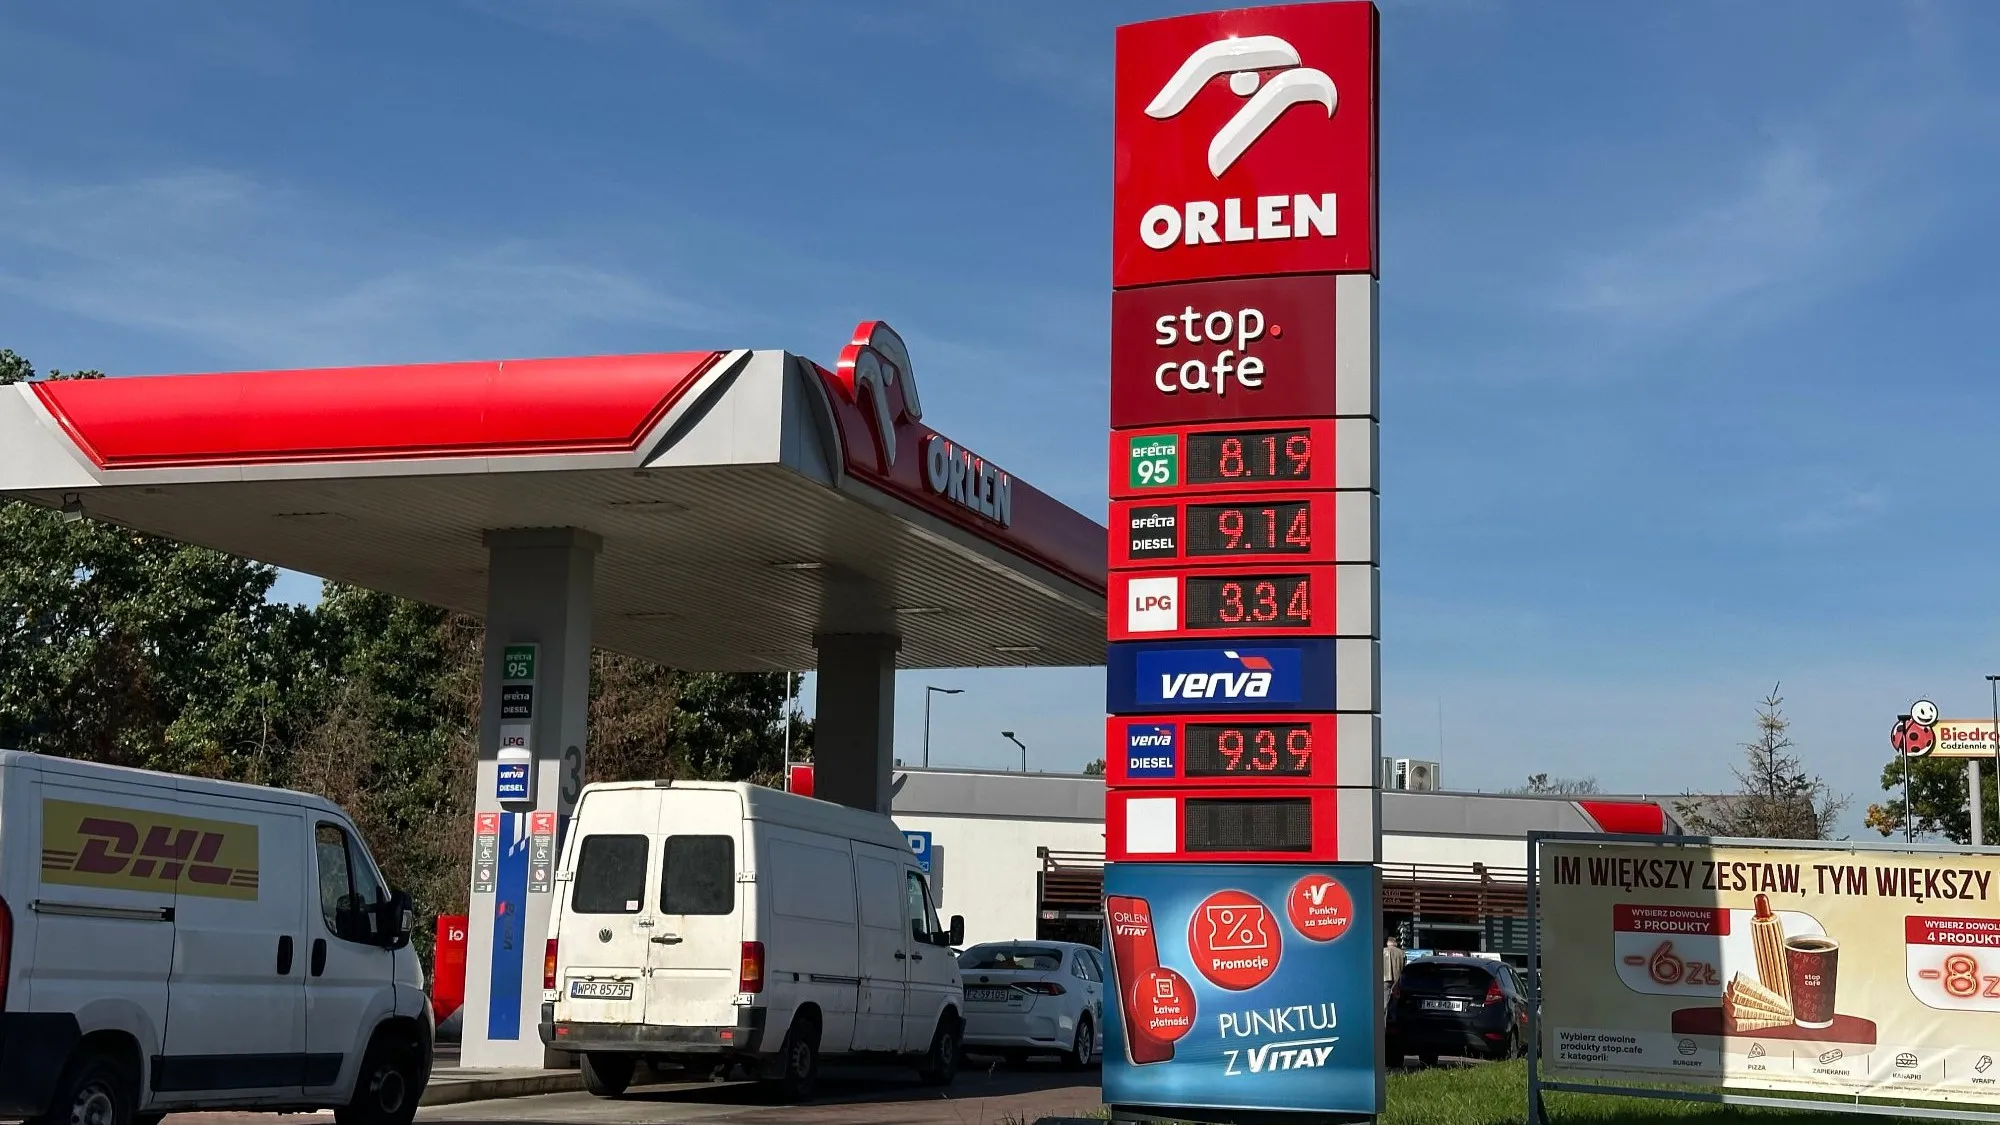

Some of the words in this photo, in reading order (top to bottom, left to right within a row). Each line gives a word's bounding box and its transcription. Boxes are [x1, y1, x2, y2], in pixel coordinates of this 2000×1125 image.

[1140, 193, 1337, 250] ORLEN
[1155, 350, 1264, 394] cafe
[1219, 435, 1311, 477] 8.19
[1137, 459, 1170, 484] 95
[926, 435, 1012, 529] ORLEN
[1218, 508, 1311, 549] 9.14
[1132, 537, 1175, 551] DIESEL
[1135, 595, 1171, 612] LPG
[1219, 580, 1311, 622] 3.34
[508, 662, 527, 677] 95
[1161, 672, 1273, 699] verva
[503, 705, 529, 714] DIESEL
[503, 737, 525, 746] LPG
[1131, 735, 1171, 747] verva
[1940, 742, 1987, 750] Codziennie
[1218, 729, 1312, 771] 9.39
[1130, 757, 1173, 769] DIESEL
[499, 770, 524, 779] verva
[562, 745, 582, 805] 3
[499, 784, 525, 792] DIESEL
[73, 817, 234, 885] DHL
[1553, 856, 1581, 885] IM
[1588, 857, 1695, 893] WIĘKSZY
[1702, 861, 1806, 898] ZESTAW,
[1813, 865, 1868, 896] TYM
[1875, 867, 1991, 903] WIĘKSZY
[1309, 906, 1338, 916] Punkty
[1631, 908, 1668, 917] WYBIERZ
[1669, 910, 1712, 919] DOWOLNE
[1114, 912, 1148, 924] ORLEN
[1304, 919, 1316, 927] za
[1318, 916, 1347, 926] zakupy
[1115, 925, 1149, 937] VITAY
[1634, 920, 1641, 929] 3
[1644, 920, 1710, 932] PRODUKTY
[1924, 920, 1964, 930] WYBIERZ
[1927, 933, 1936, 942] 4
[1212, 957, 1269, 971] Promocje
[1804, 973, 1821, 981] stop
[577, 983, 597, 994] WPR
[600, 984, 631, 995] 8575F
[1153, 1005, 1180, 1014] Łatwe
[1150, 1016, 1189, 1029] płatności
[1219, 1002, 1337, 1038] PUNKTUJ
[1560, 1032, 1596, 1043] Wybierz
[1598, 1034, 1636, 1044] dowolne
[1560, 1042, 1600, 1053] produkty
[1602, 1043, 1643, 1054] stop.cafe
[1223, 1051, 1241, 1076] Z
[1247, 1037, 1340, 1073] VITAY
[1567, 1052, 1609, 1063] kategorii:
[1672, 1059, 1702, 1067] BURGERY
[1812, 1067, 1850, 1077] ZAPIEKANKI
[1971, 1077, 1996, 1085] WRAPY
